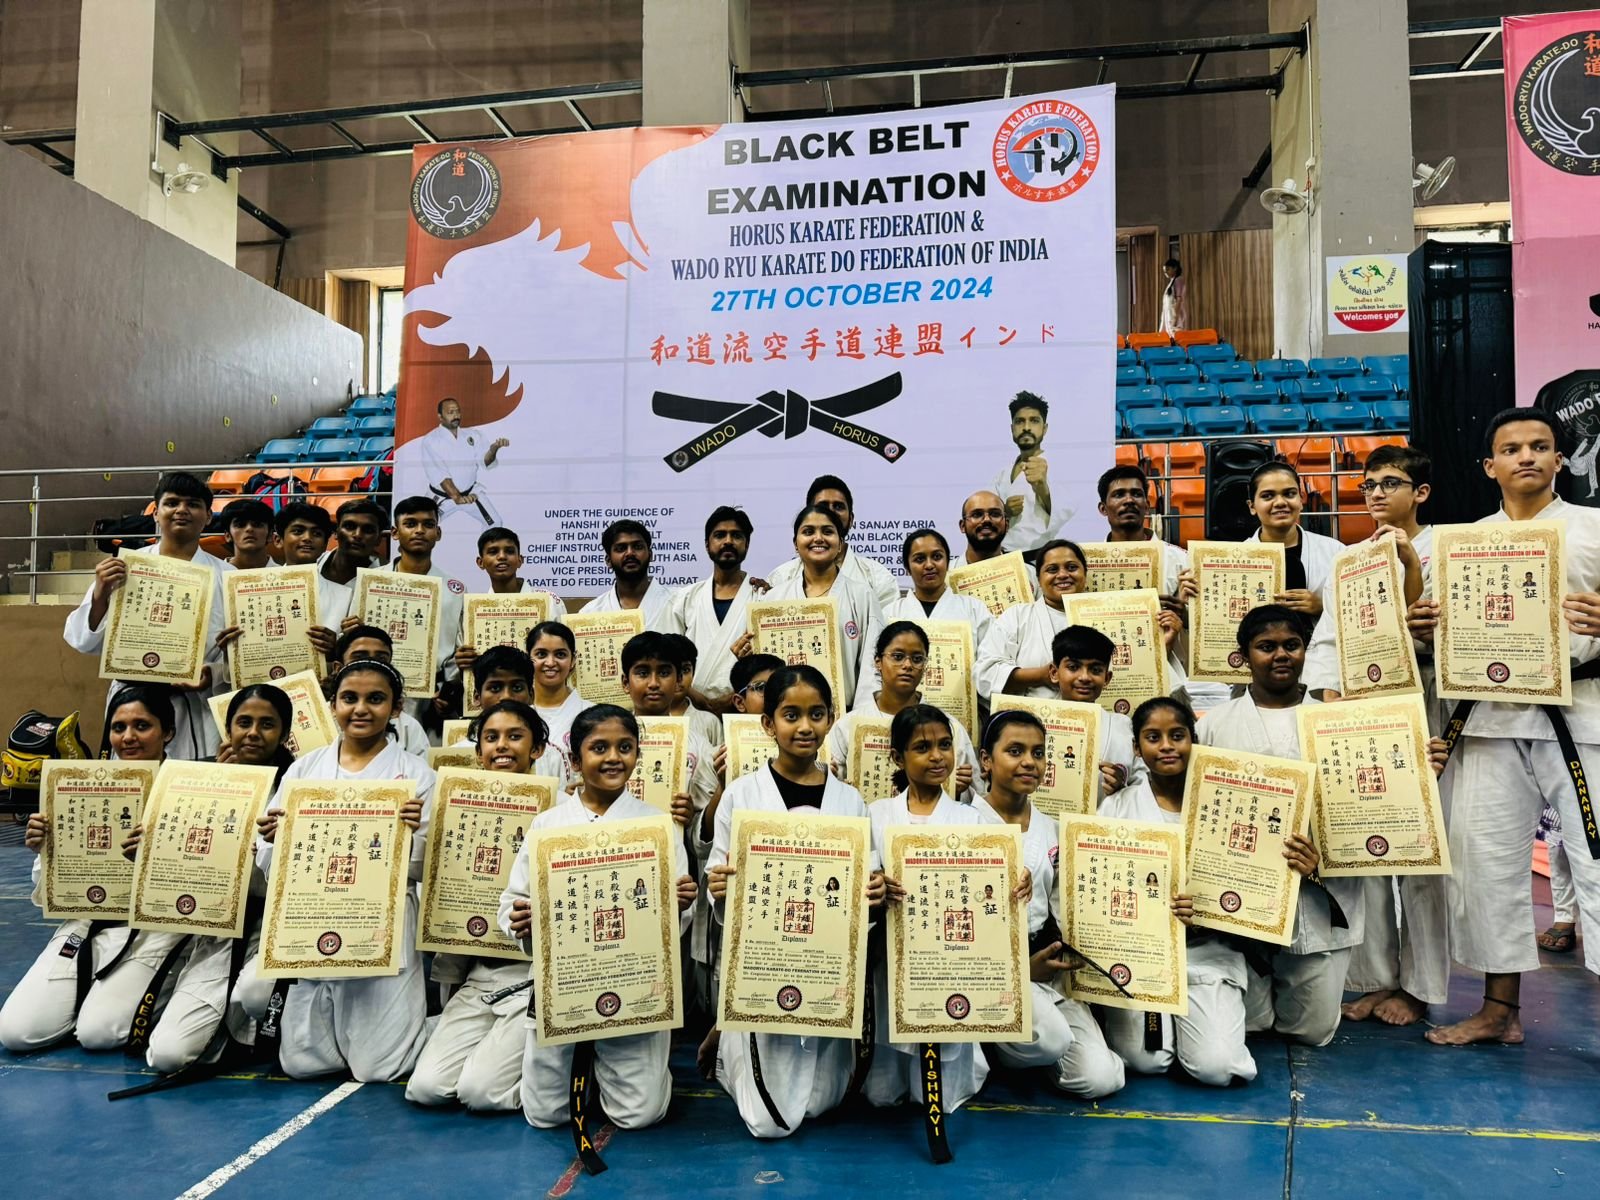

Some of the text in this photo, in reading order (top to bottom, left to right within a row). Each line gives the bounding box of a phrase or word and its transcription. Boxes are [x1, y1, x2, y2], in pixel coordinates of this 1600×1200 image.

[1518, 38, 1578, 136] WADO-RYU KARATE-DO
[724, 121, 969, 166] BLACK BELT
[995, 102, 1097, 168] HORUS KARATE FEDERATION
[469, 152, 498, 180] FEDERATION
[489, 191, 498, 208] INDIA
[708, 170, 986, 214] EXAMINATION
[730, 210, 984, 247] HORUS KARATE FEDERATION &
[672, 238, 1049, 281] WADO RYU KARATE DO FEDERATION OF INDIA
[711, 276, 993, 311] 27TH OCTOBER 2024
[650, 322, 1056, 366] 和道流空手道連盟インド
[1556, 396, 1595, 423] WADO
[691, 424, 736, 456] WADO
[832, 421, 880, 447] HORUS
[544, 508, 674, 518] UNDER THE GUIDENCE OF
[561, 520, 600, 529] HANSHI
[860, 521, 900, 529] SANJAY
[903, 520, 936, 529] BARIA
[527, 542, 690, 552] CHIEF INSTRUC AMINER
[555, 532, 574, 541] 8TH
[578, 532, 598, 540] DAN
[868, 532, 903, 541] BLACK
[581, 555, 604, 563] DIRE
[673, 554, 697, 562] ASIA
[880, 544, 904, 552] DIRE
[551, 567, 579, 575] VICE
[581, 566, 614, 575] PRESID
[560, 578, 575, 586] DO
[657, 577, 698, 585] UJARAT
[1570, 760, 1597, 839] DHANANJAY
[551, 859, 576, 868] WADORYU
[577, 856, 604, 865] KARATE-DO
[605, 852, 633, 862] FEDERATION
[641, 850, 654, 858] INDIA
[775, 846, 801, 854] KARATE-DO
[802, 847, 830, 855] FEDERATION
[593, 942, 619, 951] Diploma
[781, 934, 807, 942] Diploma
[574, 1076, 592, 1152] HIYA
